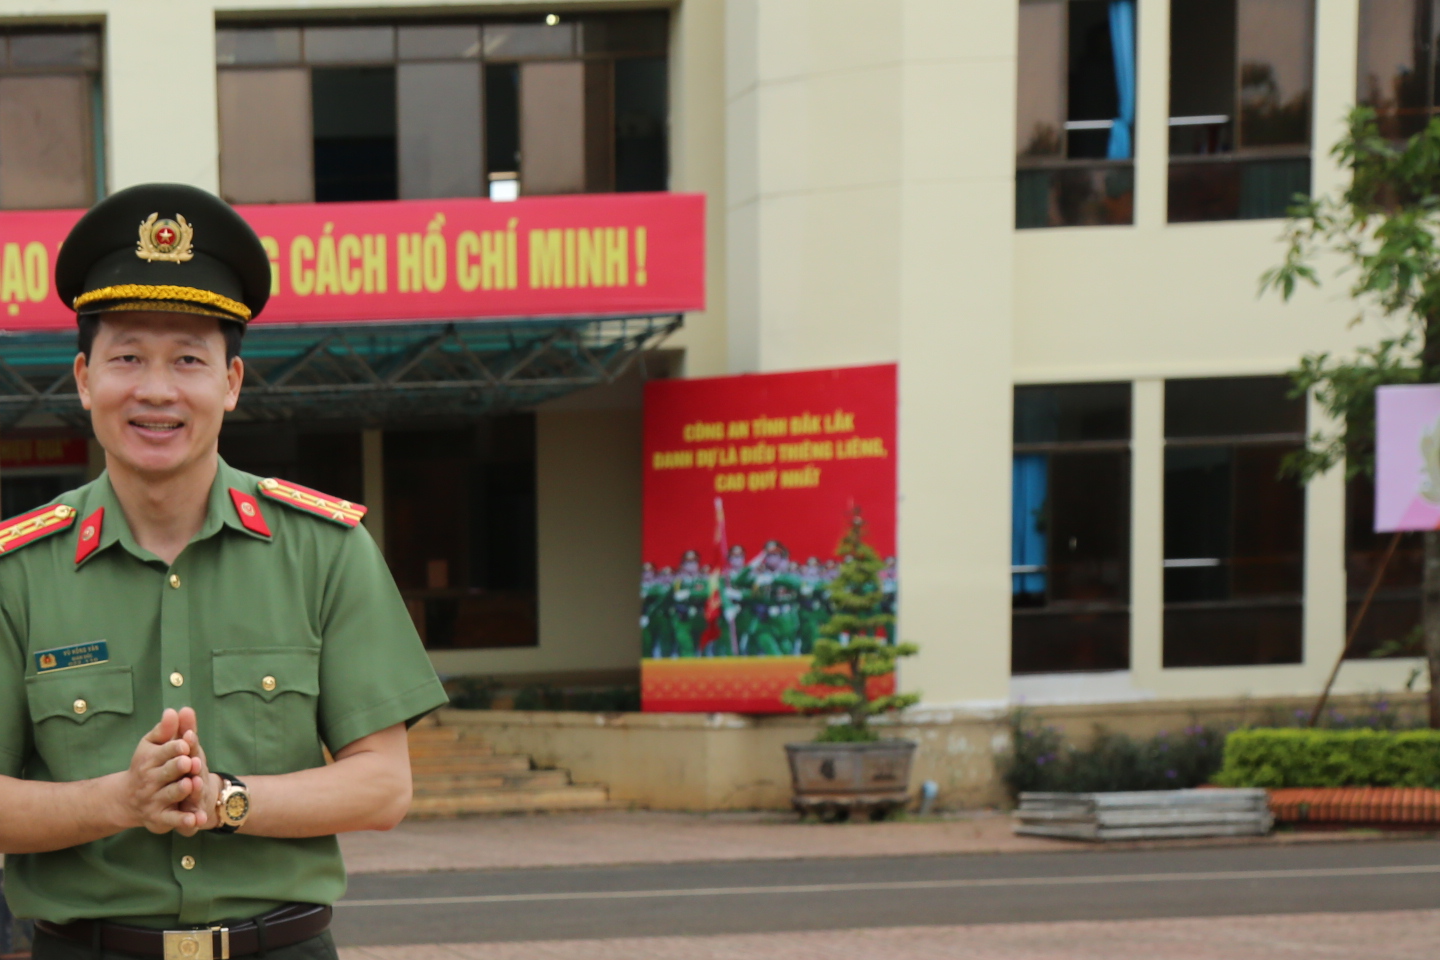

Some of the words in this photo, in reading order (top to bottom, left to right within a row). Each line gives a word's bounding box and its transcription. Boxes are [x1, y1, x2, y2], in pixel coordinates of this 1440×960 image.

[290, 222, 387, 296] CÁCH
[398, 213, 446, 293] HỒ
[456, 217, 518, 292] CHÍ
[529, 226, 628, 289] MINH
[683, 420, 724, 442] CÔNG
[727, 421, 750, 439] AN
[653, 450, 693, 470] DANH
[719, 444, 738, 466] LÀ
[778, 439, 834, 462] THIÊNG
[714, 472, 746, 492] CAO
[780, 462, 821, 489] NHẤT
